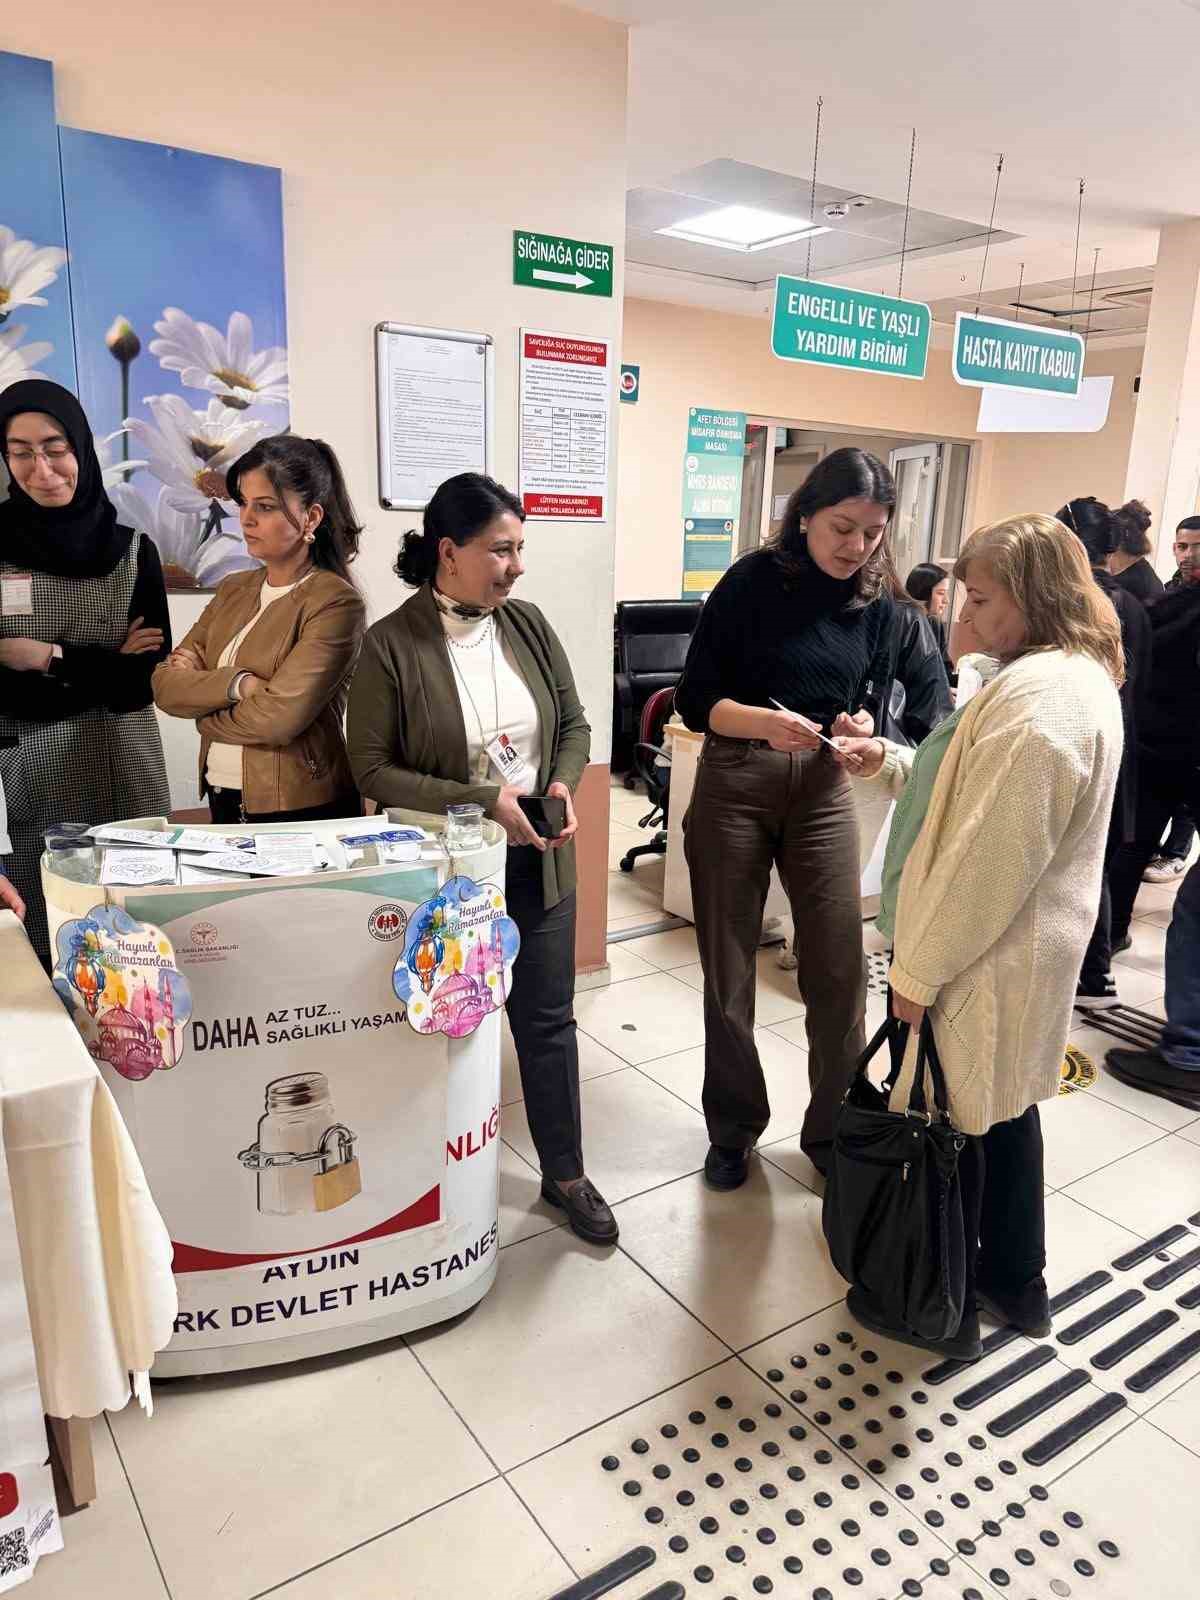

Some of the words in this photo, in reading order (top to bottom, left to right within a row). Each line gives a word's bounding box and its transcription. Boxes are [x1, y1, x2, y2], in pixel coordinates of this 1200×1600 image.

[518, 235, 573, 265] SIĞINAĞA
[575, 244, 609, 270] GİDER
[787, 291, 854, 325] ENGELLİ
[858, 305, 877, 329] VE
[881, 309, 921, 338] YAŞLI
[796, 328, 857, 359] YARDIM
[859, 338, 908, 367] BİRİMİ
[962, 335, 1002, 369] HASTA
[1003, 341, 1040, 374] KAYIT
[1039, 347, 1076, 379] KABUL
[448, 909, 505, 933] Ramazanlar
[459, 899, 492, 918] Hayırlı
[105, 951, 175, 968] Ramazanlar
[118, 940, 157, 955] Hayırlı
[192, 1016, 260, 1051] DAHA
[265, 1010, 289, 1024] AZ
[294, 1004, 341, 1021] TUZ...
[266, 1020, 347, 1044] SAĞLIKLI
[351, 1011, 407, 1031] YAŞAM
[231, 1284, 359, 1327] DEVLET
